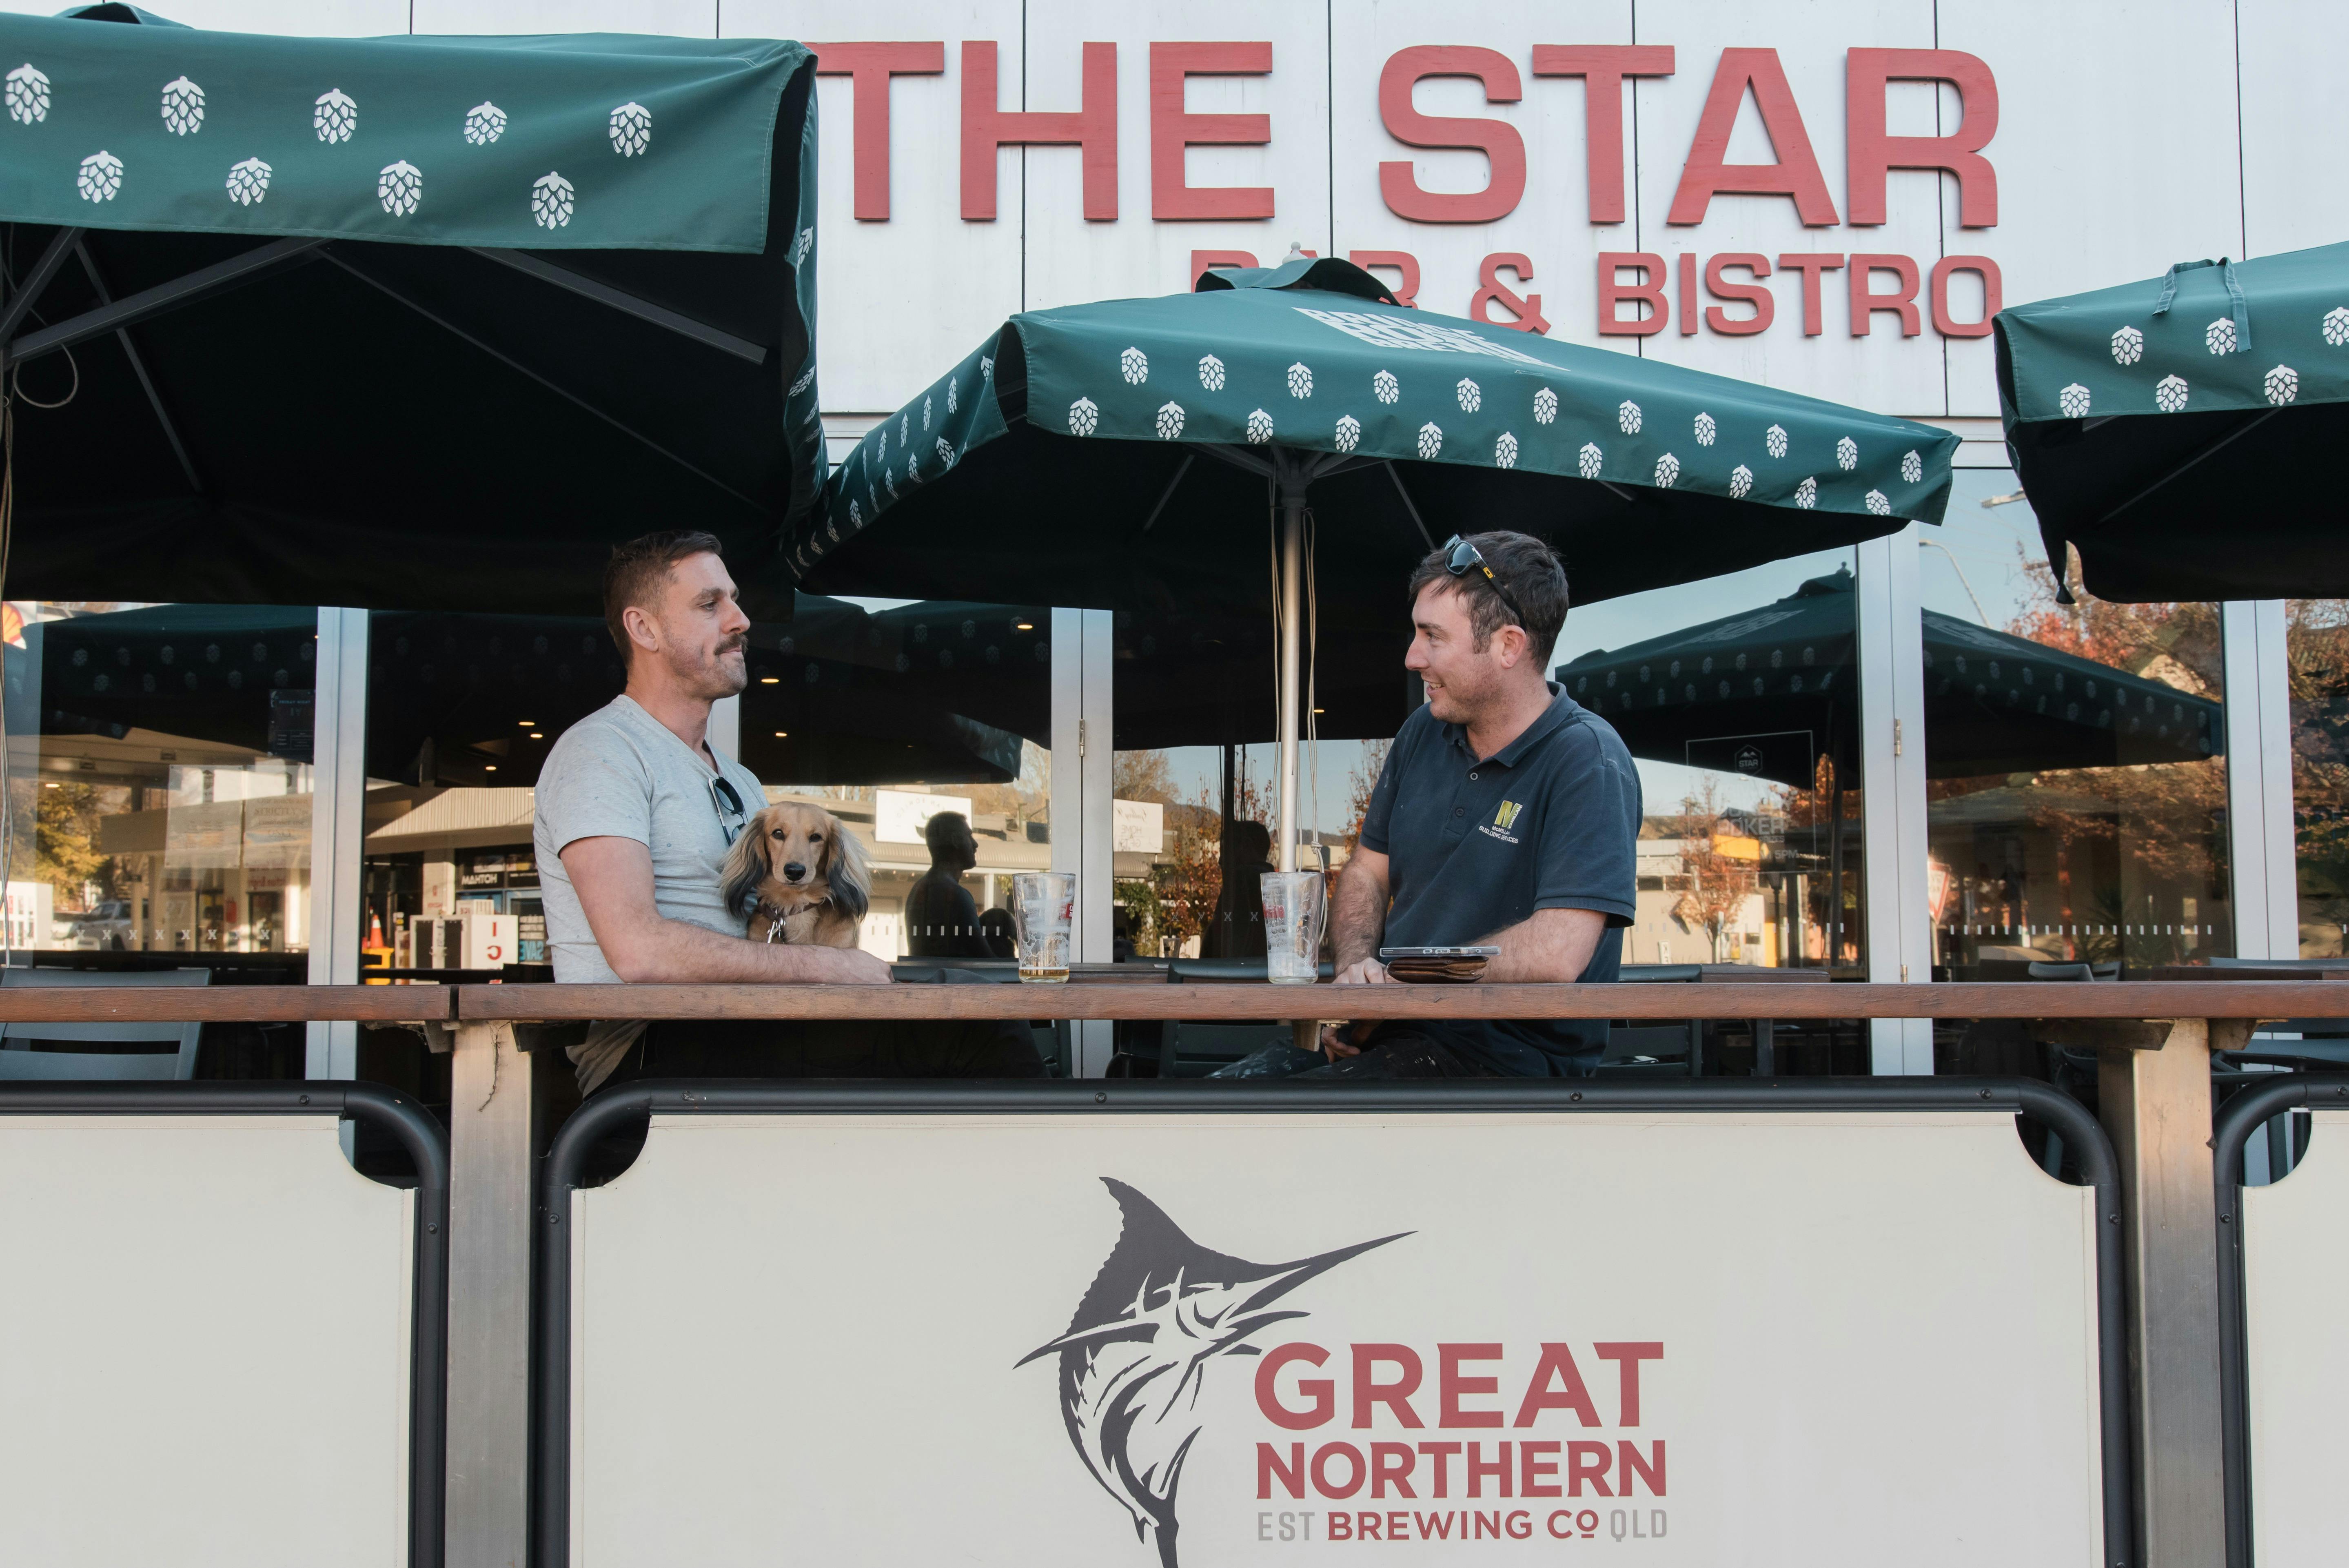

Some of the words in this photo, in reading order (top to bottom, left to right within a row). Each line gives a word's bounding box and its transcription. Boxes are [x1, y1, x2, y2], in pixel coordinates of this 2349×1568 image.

[801, 41, 1275, 221] THE
[1379, 45, 1999, 227] STAR
[1471, 252, 1551, 335] &
[1598, 252, 2003, 337] BISTRO
[1738, 758, 1759, 767] STAR
[1479, 825, 1501, 838] BUILDING
[1500, 834, 1519, 843] SERVICES
[1491, 825, 1511, 836] McMILLAN
[1717, 816, 1785, 836] POKER
[1254, 1342, 1664, 1430] GREAT
[1256, 1440, 1666, 1499] NORTHERN
[1258, 1511, 1315, 1541] EST
[1328, 1510, 1532, 1541] BREWING
[1610, 1509, 1667, 1542] QLD
